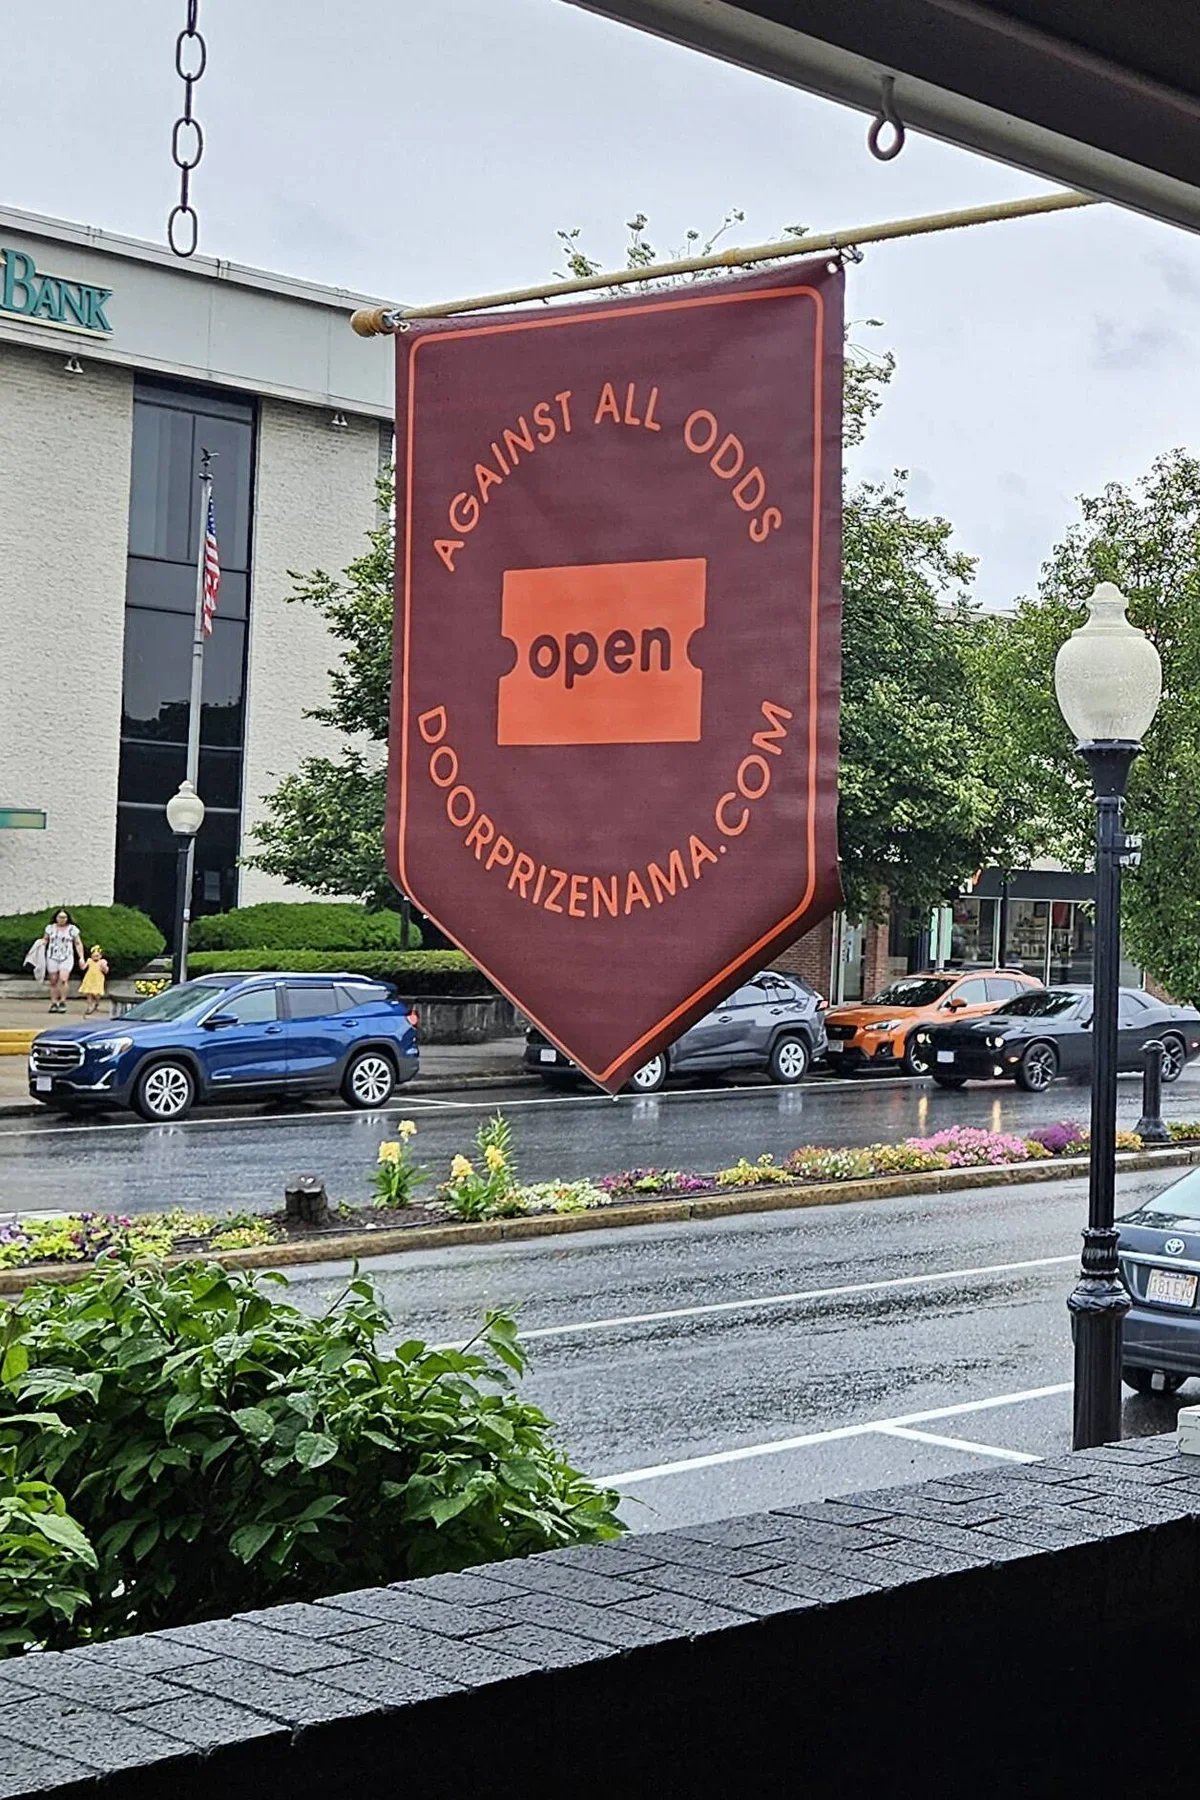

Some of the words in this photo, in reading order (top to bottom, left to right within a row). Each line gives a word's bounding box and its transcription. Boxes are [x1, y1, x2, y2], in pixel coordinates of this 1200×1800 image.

[0, 248, 112, 331] BANK
[432, 391, 571, 572] AGAINST
[595, 382, 661, 431] ALL
[684, 409, 782, 543] ODDS
[528, 626, 671, 690] open
[418, 701, 793, 918] DOORPRIZENAMA.COM
